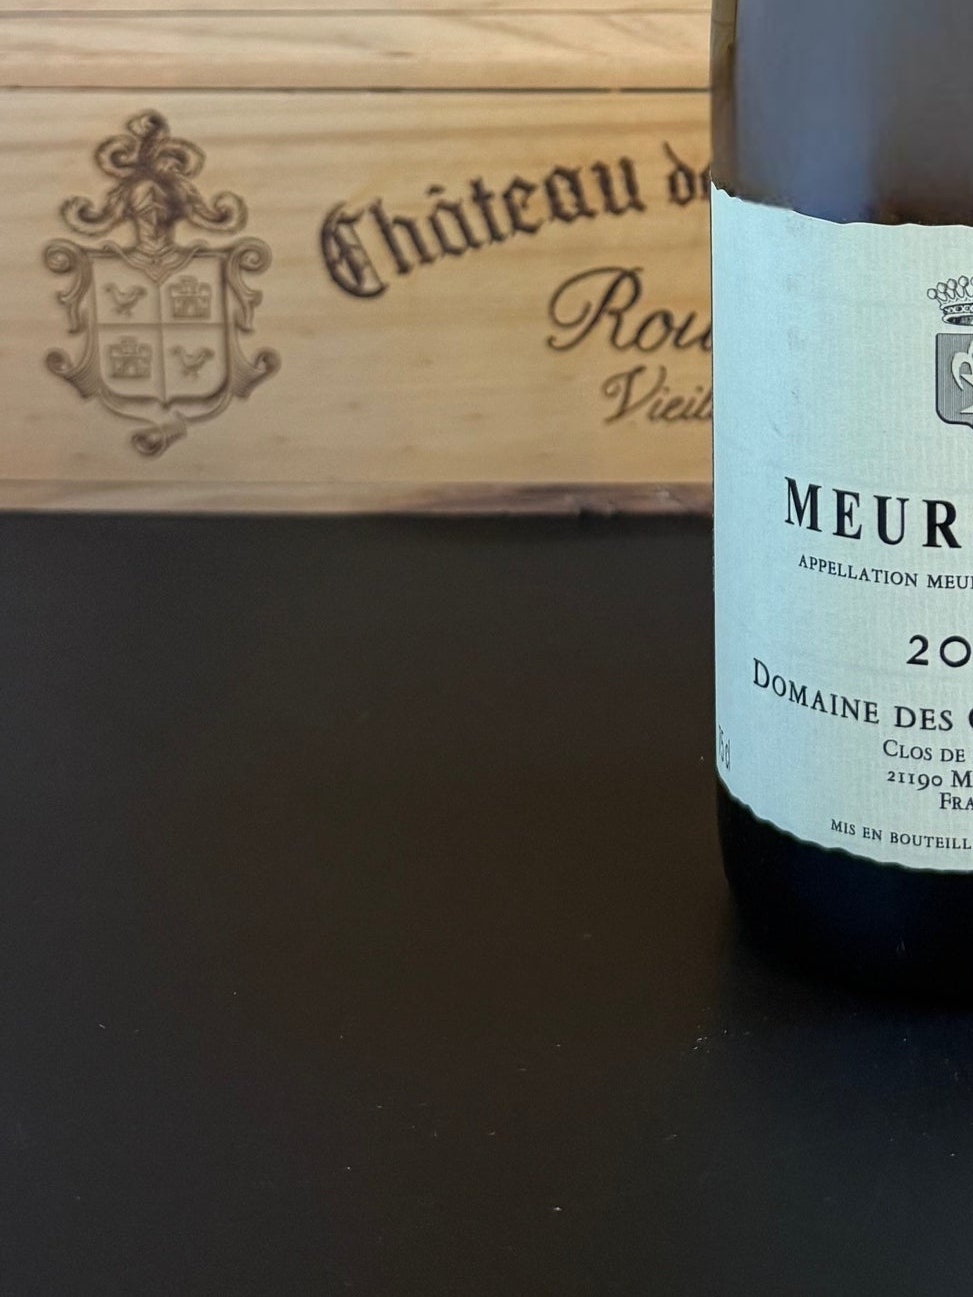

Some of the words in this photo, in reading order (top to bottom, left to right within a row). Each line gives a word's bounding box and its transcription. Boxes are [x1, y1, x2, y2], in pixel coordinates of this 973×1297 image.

[319, 155, 648, 299] Château
[798, 553, 919, 588] APPELLATION
[752, 657, 880, 725] DOMAINE
[893, 705, 954, 732] DES
[882, 739, 933, 762] CLOS
[940, 747, 966, 763] DE
[886, 770, 943, 792] 21190
[830, 818, 856, 836] MIS
[862, 826, 883, 842] EN
